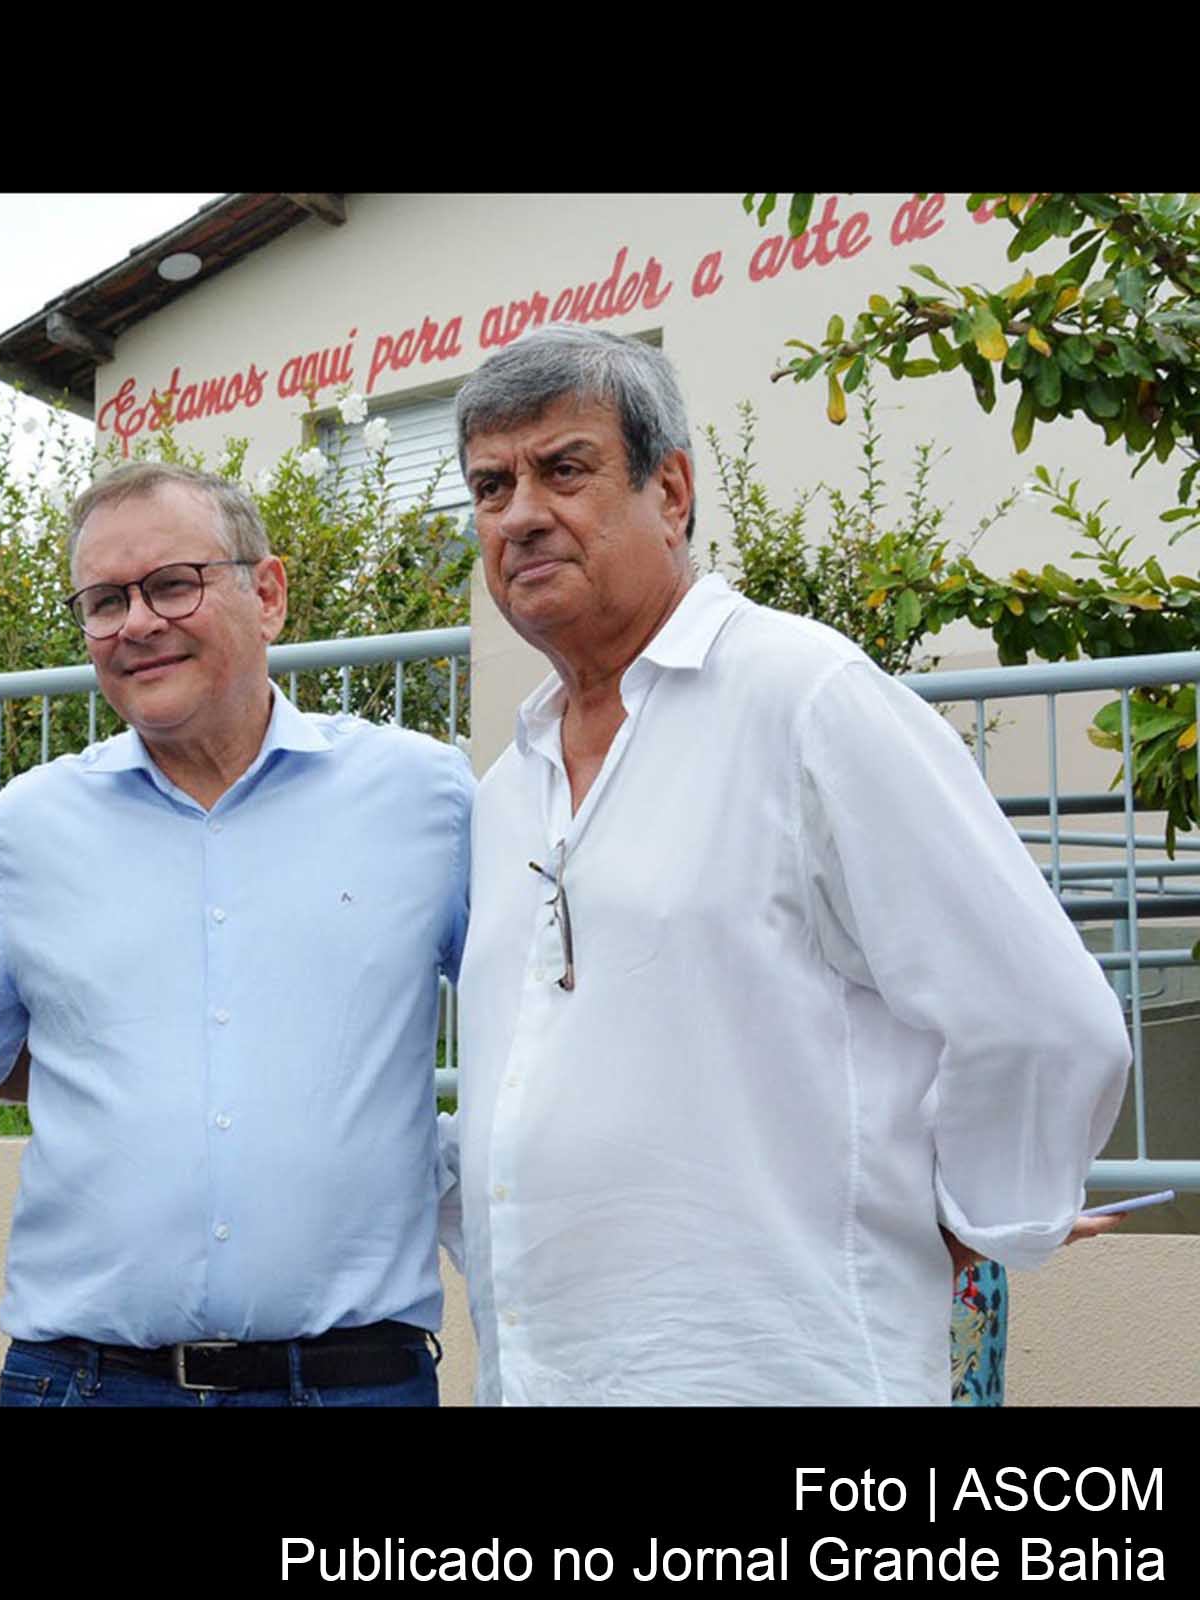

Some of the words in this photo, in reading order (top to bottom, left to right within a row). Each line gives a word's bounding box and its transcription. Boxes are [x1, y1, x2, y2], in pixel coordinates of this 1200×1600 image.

[97, 366, 267, 457] Estamos
[277, 327, 357, 409] aqui
[367, 315, 463, 393] para
[479, 246, 672, 349] aprender
[692, 250, 722, 298] a
[749, 196, 872, 283] arte
[891, 193, 945, 246] de
